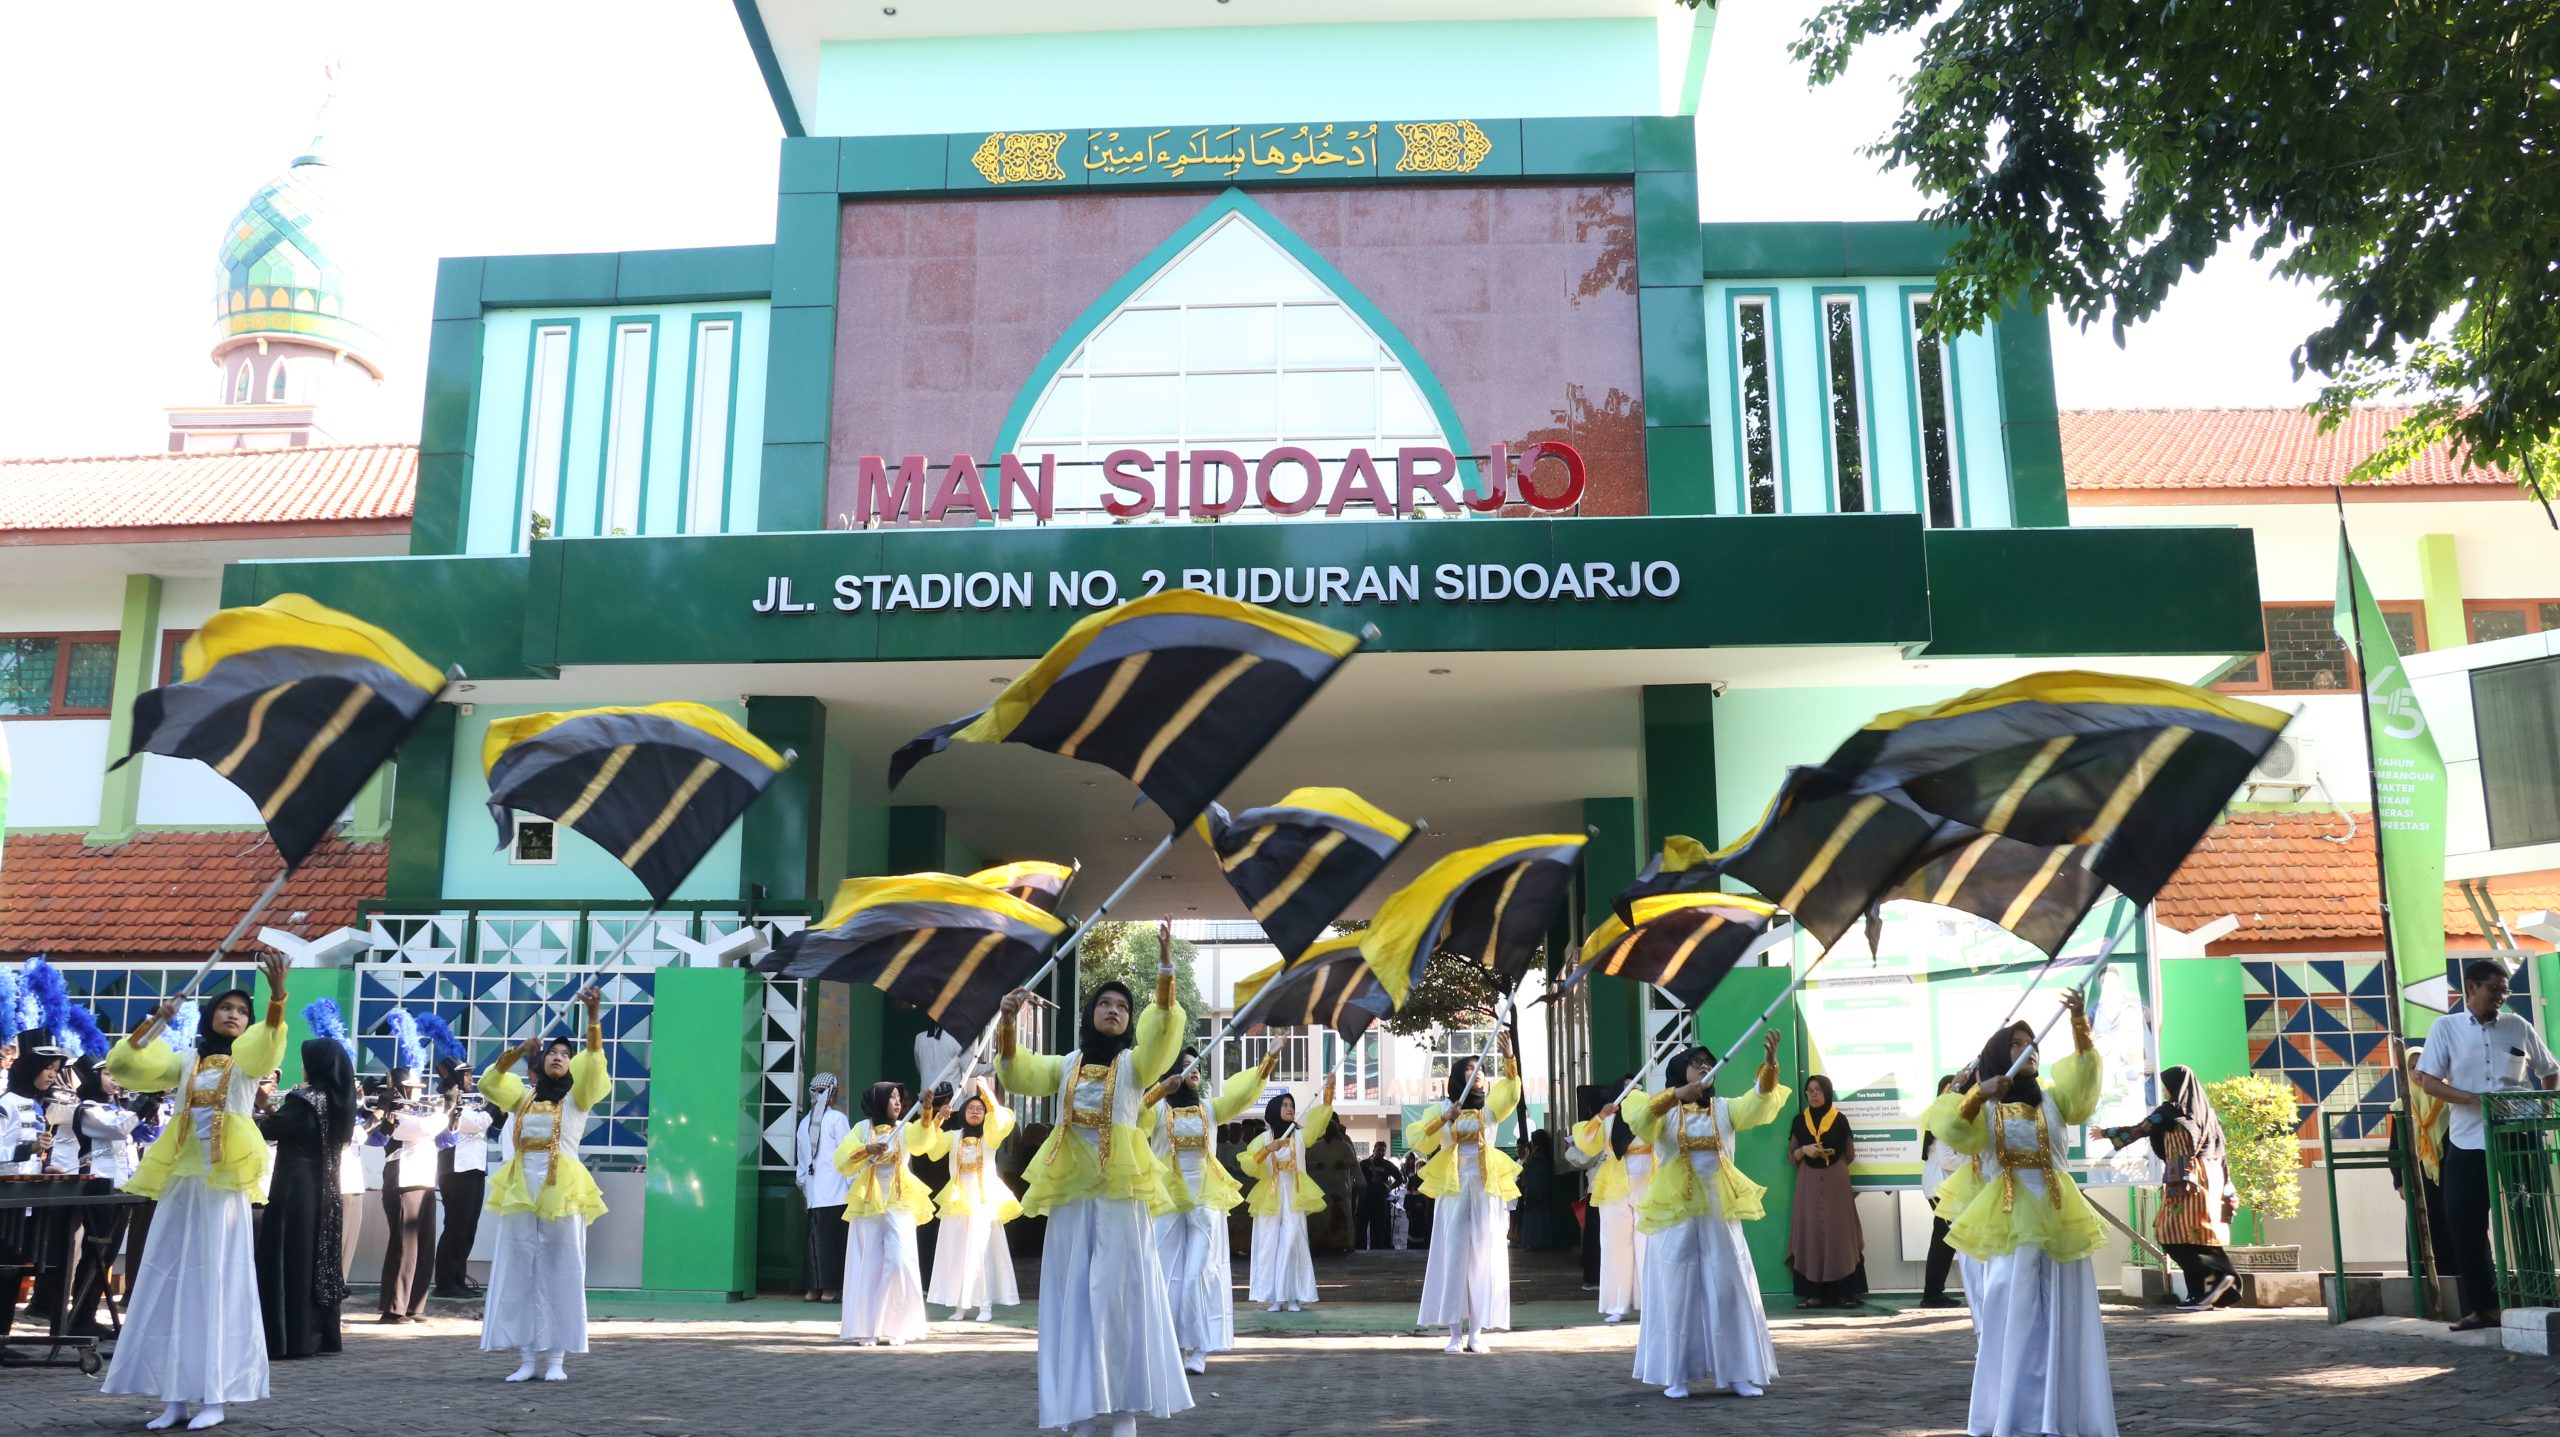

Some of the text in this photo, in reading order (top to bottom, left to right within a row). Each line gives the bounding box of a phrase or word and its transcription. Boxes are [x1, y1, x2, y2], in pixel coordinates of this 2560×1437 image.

[856, 441, 1586, 523] MAN SIDOARJO
[752, 560, 1681, 612] JL. STADION NO. 2 BUDURAN SIDOARJO
[2377, 758, 2415, 768] TAHUN
[2376, 771, 2435, 781] MBANGUN
[2377, 783, 2416, 793] RAKTER
